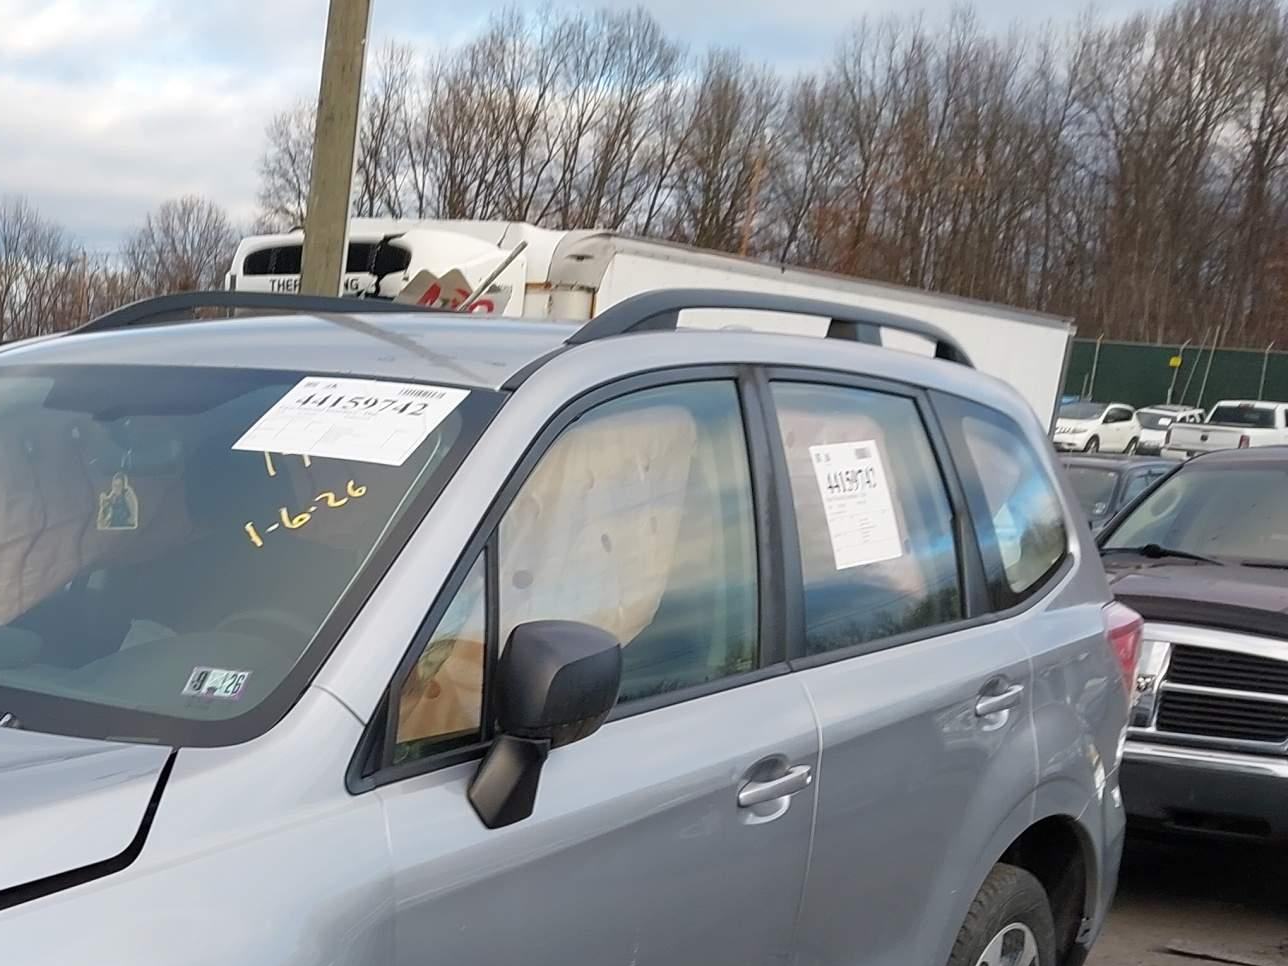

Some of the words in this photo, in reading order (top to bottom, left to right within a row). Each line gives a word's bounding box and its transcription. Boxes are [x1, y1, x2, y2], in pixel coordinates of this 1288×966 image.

[297, 393, 429, 416] 44159742
[245, 480, 367, 547] 1-6-26
[223, 673, 246, 695] 26
